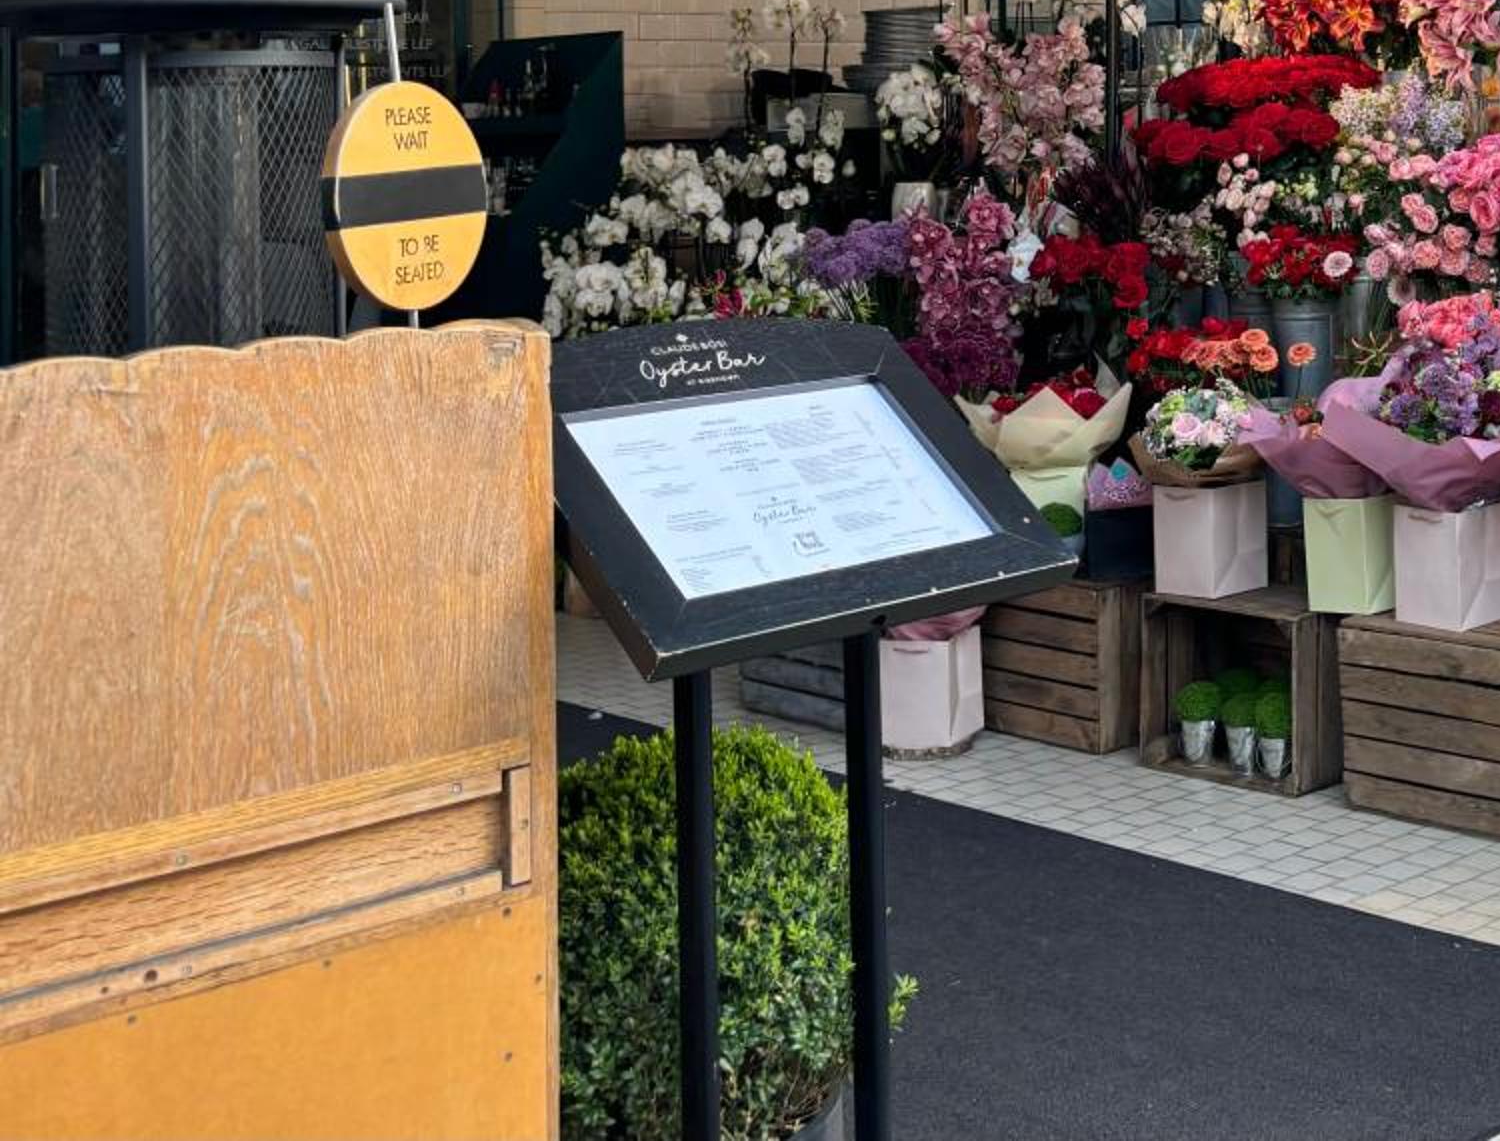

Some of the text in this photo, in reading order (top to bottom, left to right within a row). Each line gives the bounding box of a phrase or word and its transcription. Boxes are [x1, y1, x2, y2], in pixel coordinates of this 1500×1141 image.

[385, 106, 432, 126] PLEASE
[393, 130, 429, 150] WAIT
[400, 234, 440, 257] TO BE
[395, 261, 445, 286] SEATED
[640, 356, 713, 388] Oyster
[716, 350, 767, 370] Bar
